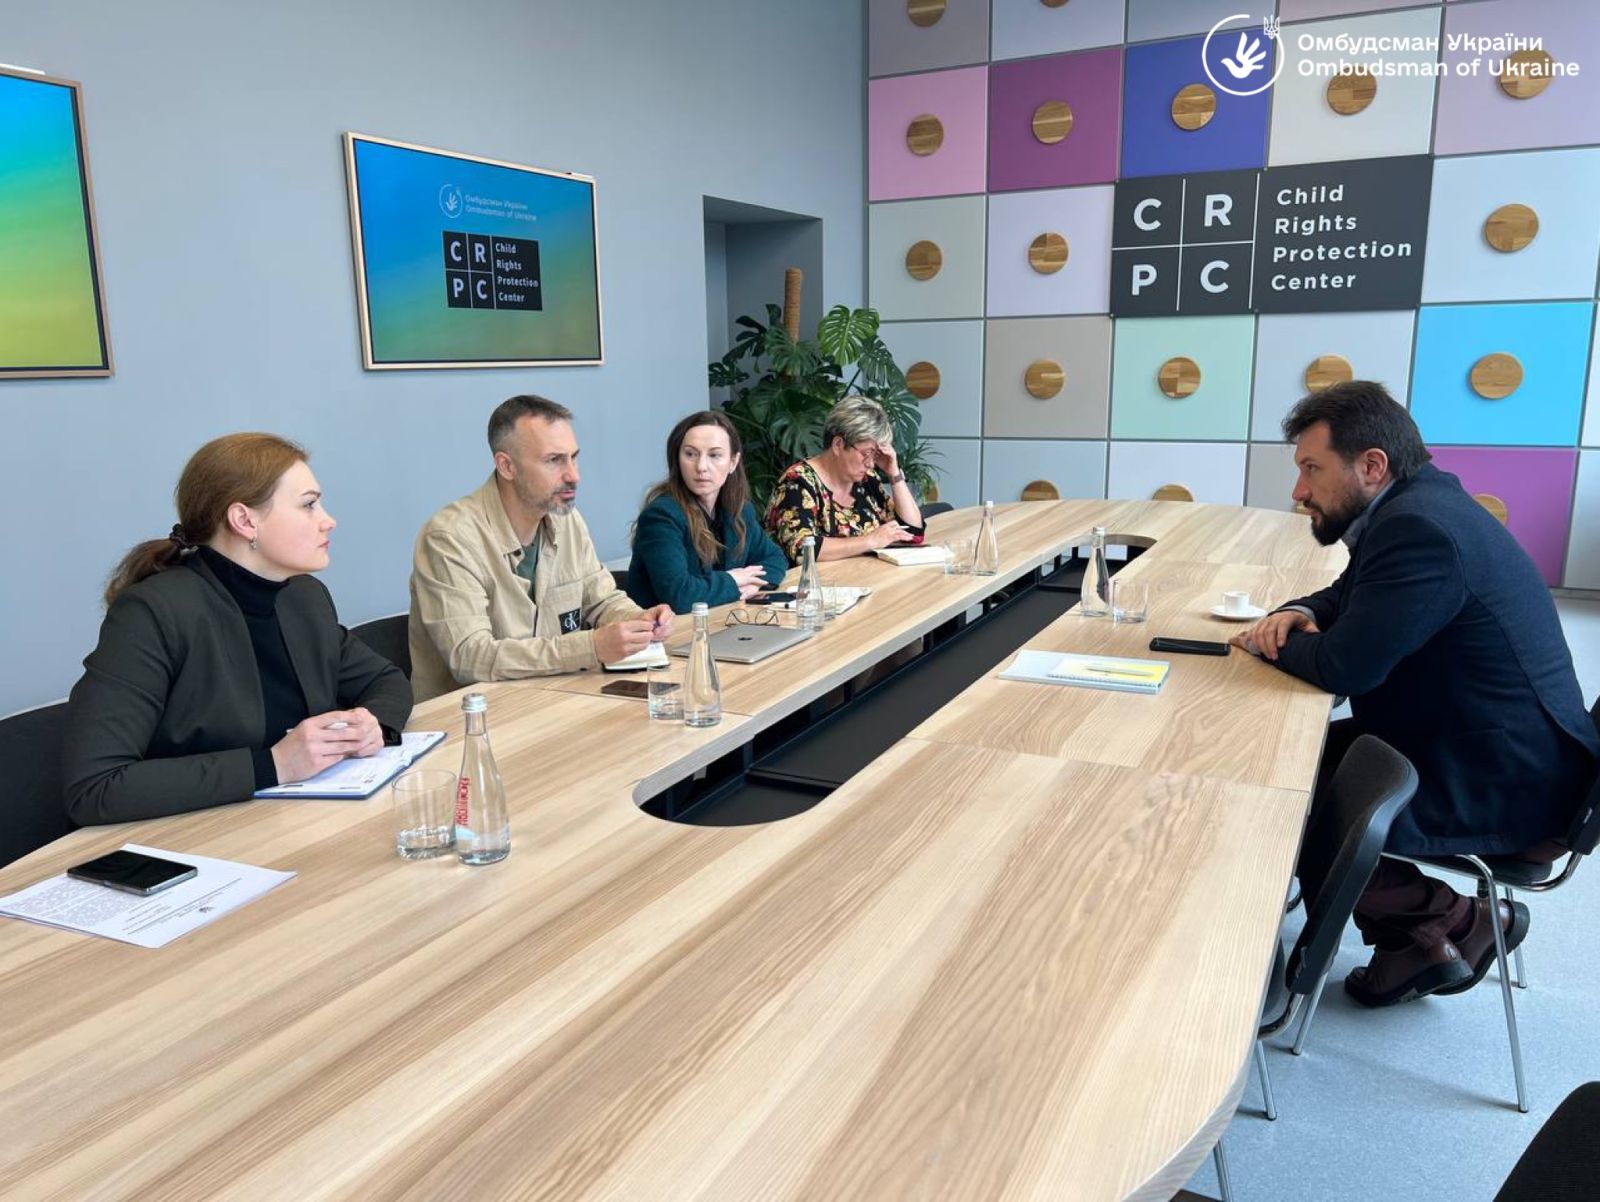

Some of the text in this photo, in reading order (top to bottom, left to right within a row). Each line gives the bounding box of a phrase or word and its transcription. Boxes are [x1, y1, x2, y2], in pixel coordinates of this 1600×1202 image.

[1276, 184, 1344, 206] Child
[1133, 194, 1233, 231] C R
[1275, 214, 1358, 235] Rights
[450, 241, 486, 263] C R
[495, 243, 516, 254] Child
[1273, 241, 1412, 263] Protection
[496, 259, 522, 272] Rights
[497, 276, 539, 288] Protection
[1131, 260, 1230, 296] P C
[1271, 272, 1356, 291] Center
[453, 278, 488, 300] P C
[498, 292, 525, 302] Center
